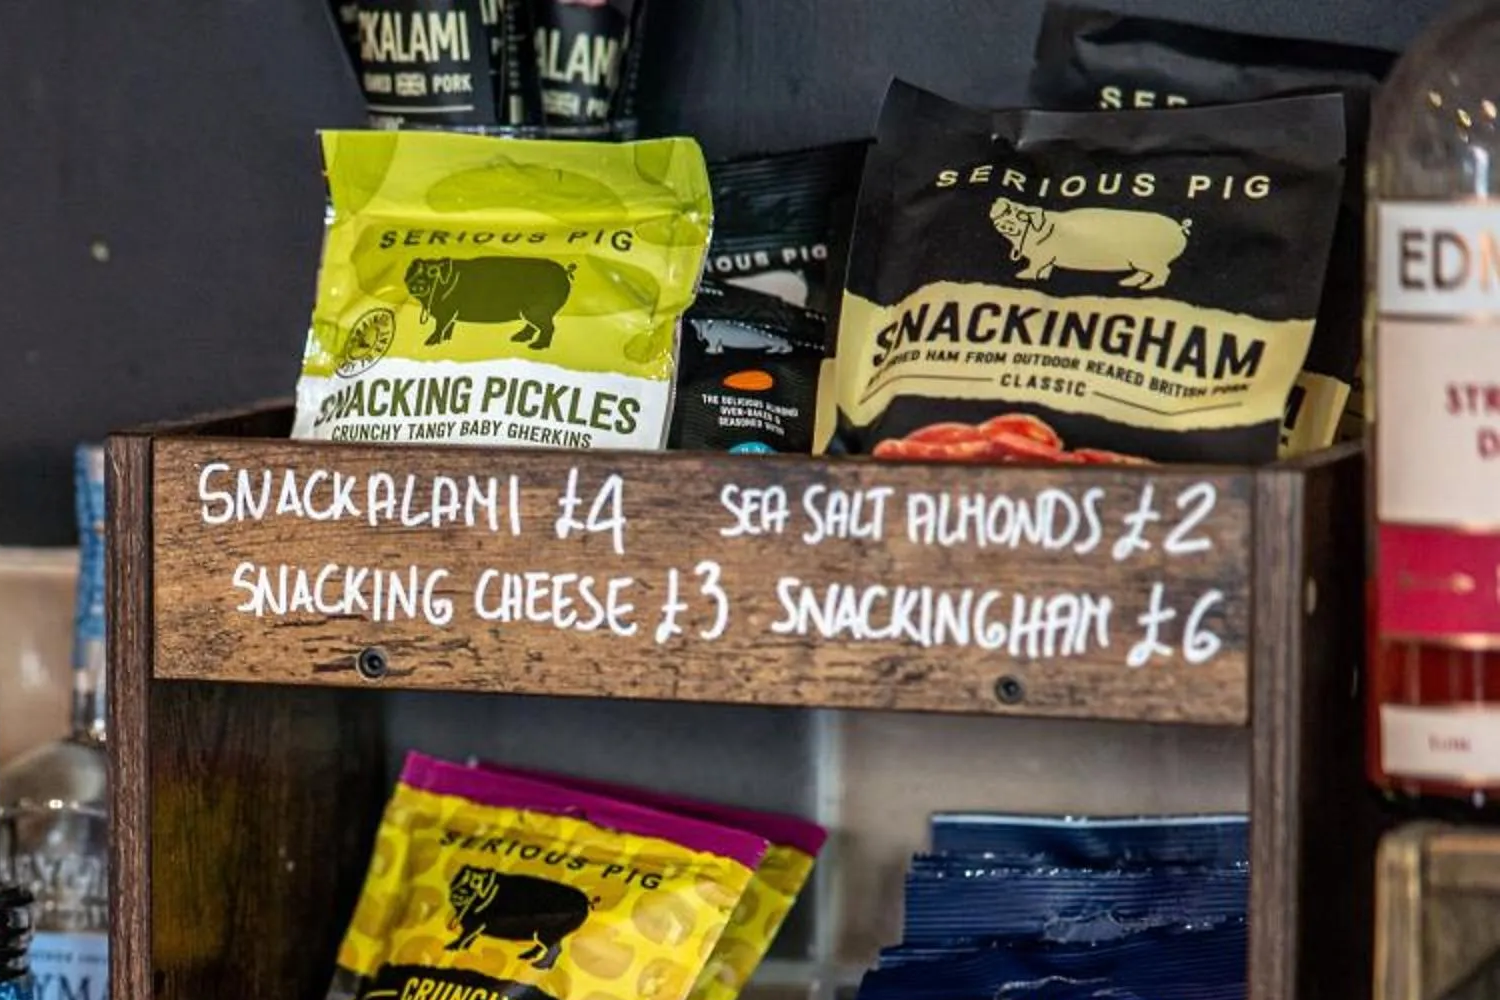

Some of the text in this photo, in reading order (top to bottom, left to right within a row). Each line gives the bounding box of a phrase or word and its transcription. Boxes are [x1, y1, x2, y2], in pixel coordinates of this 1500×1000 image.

[431, 73, 473, 93] PORK
[936, 165, 1272, 199] SERIOUS PIG
[380, 228, 633, 252] SERIOUS PIG
[782, 244, 828, 264] PIG
[872, 302, 1267, 381] SNACKINGHAM
[926, 350, 959, 362] HAM
[965, 351, 1007, 364] FROM
[1012, 352, 1080, 370] OUTDOOR
[1085, 359, 1145, 387] REARED
[1149, 377, 1208, 398] BRITISH
[1000, 373, 1088, 397] CLASSIC
[314, 375, 642, 435] SNACKING PICKLES
[331, 420, 594, 449] CRUNCHY TANGY BABY GHERKINS
[198, 462, 1219, 561] SNACKALAMI £4 SEA SALT ALMONDS £2
[231, 560, 1224, 668] SNACKING CHEESE £3 SNACKINGHAM £6
[439, 828, 663, 890] SERIOUS PIG
